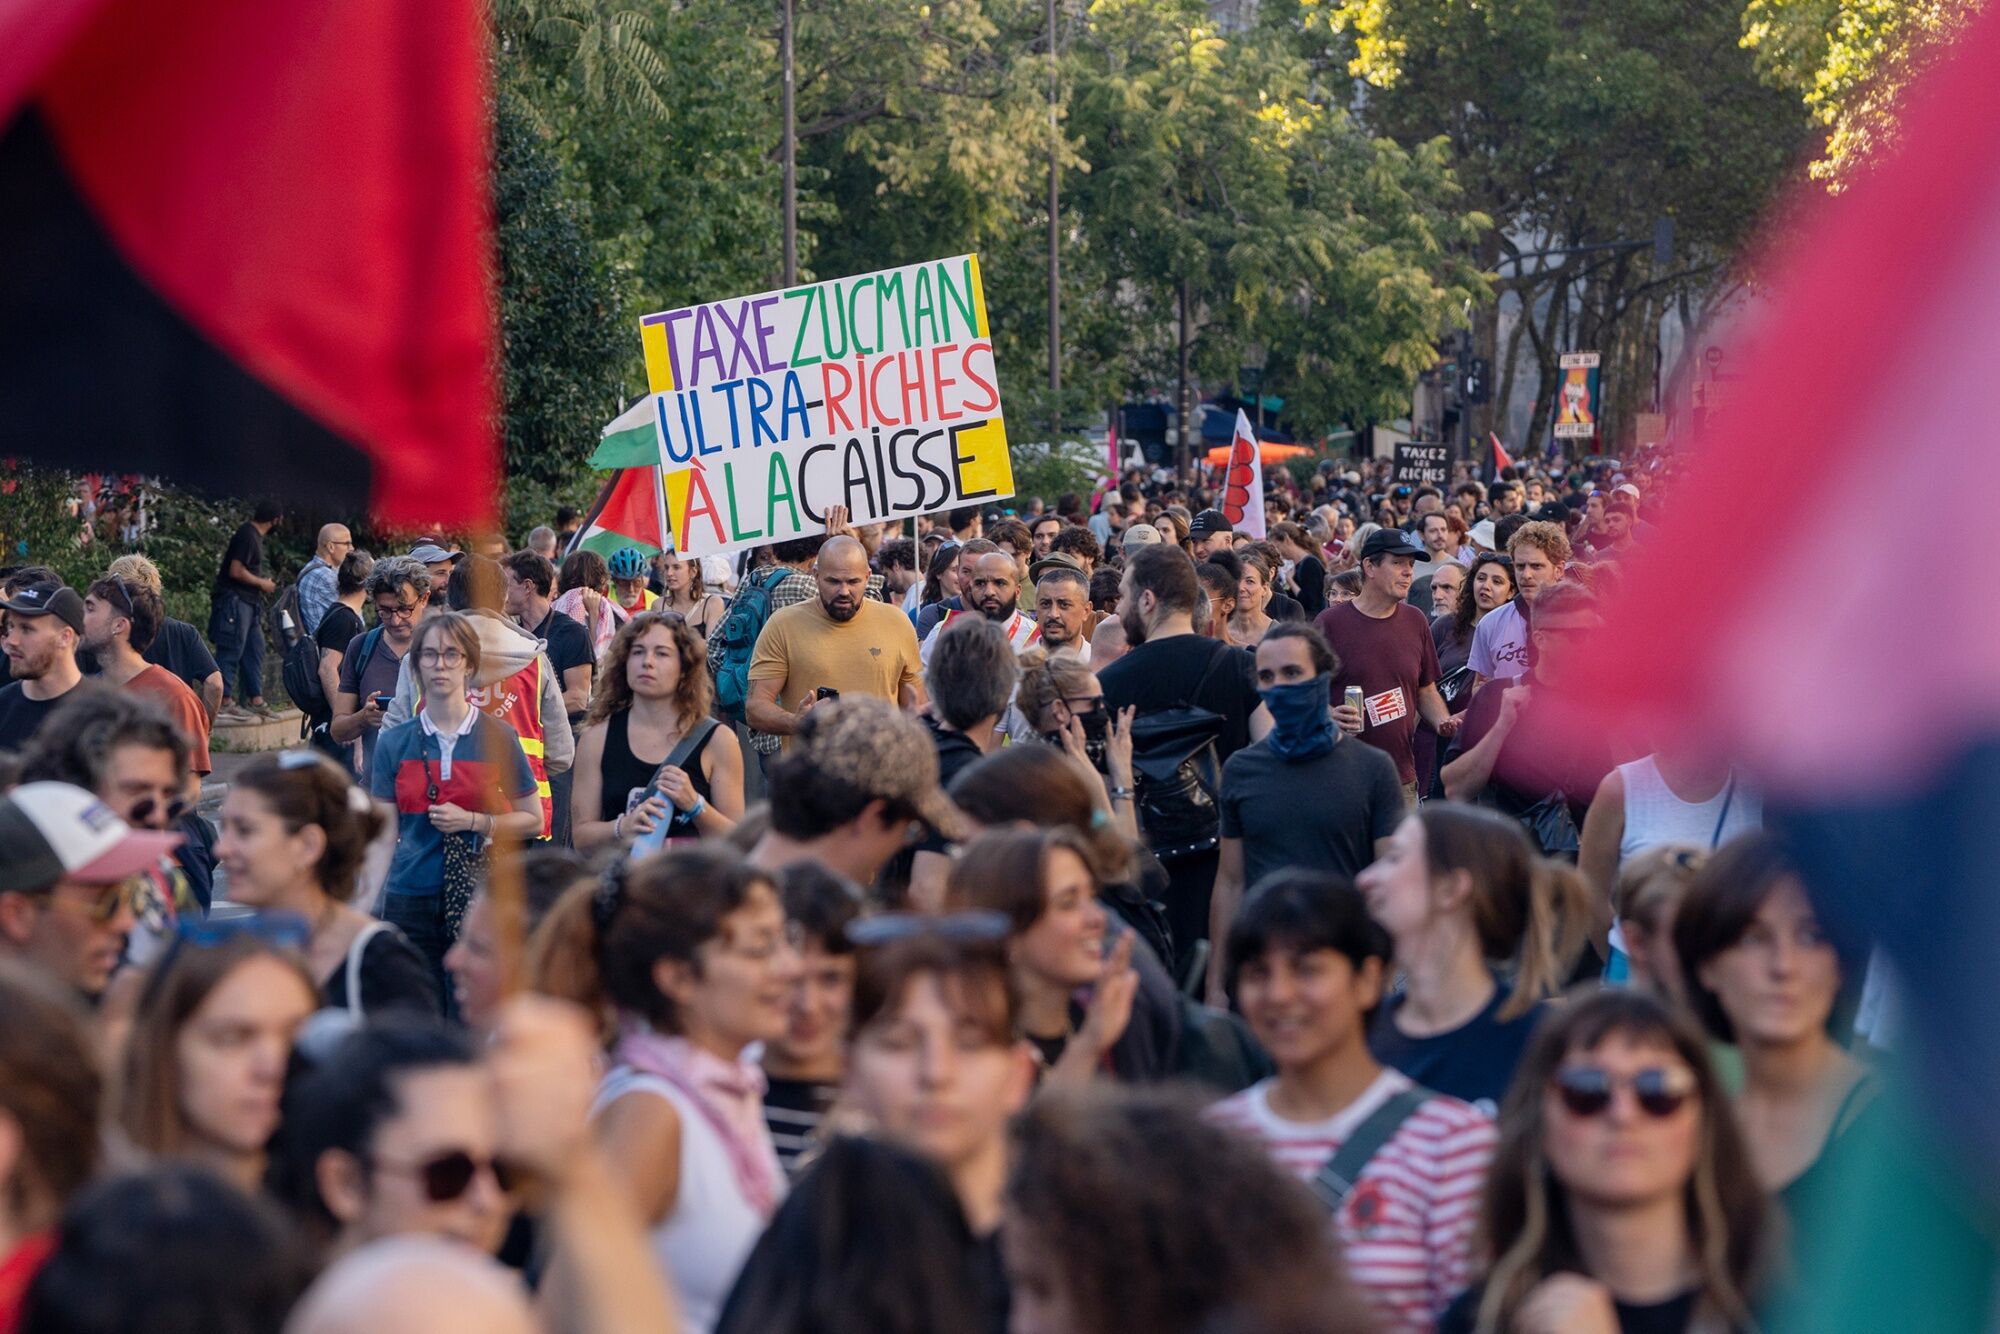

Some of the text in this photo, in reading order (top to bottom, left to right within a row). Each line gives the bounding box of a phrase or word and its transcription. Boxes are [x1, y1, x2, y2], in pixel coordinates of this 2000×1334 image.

[643, 259, 980, 391] TAXE ZUCMAN
[657, 343, 999, 463] ULTRA-RICHES
[1400, 446, 1447, 461] TAXEZ
[1413, 460, 1430, 468] LES
[680, 420, 998, 553] À LA CAISSE
[1398, 466, 1446, 482] RICHES
[1372, 692, 1400, 722] NIE
